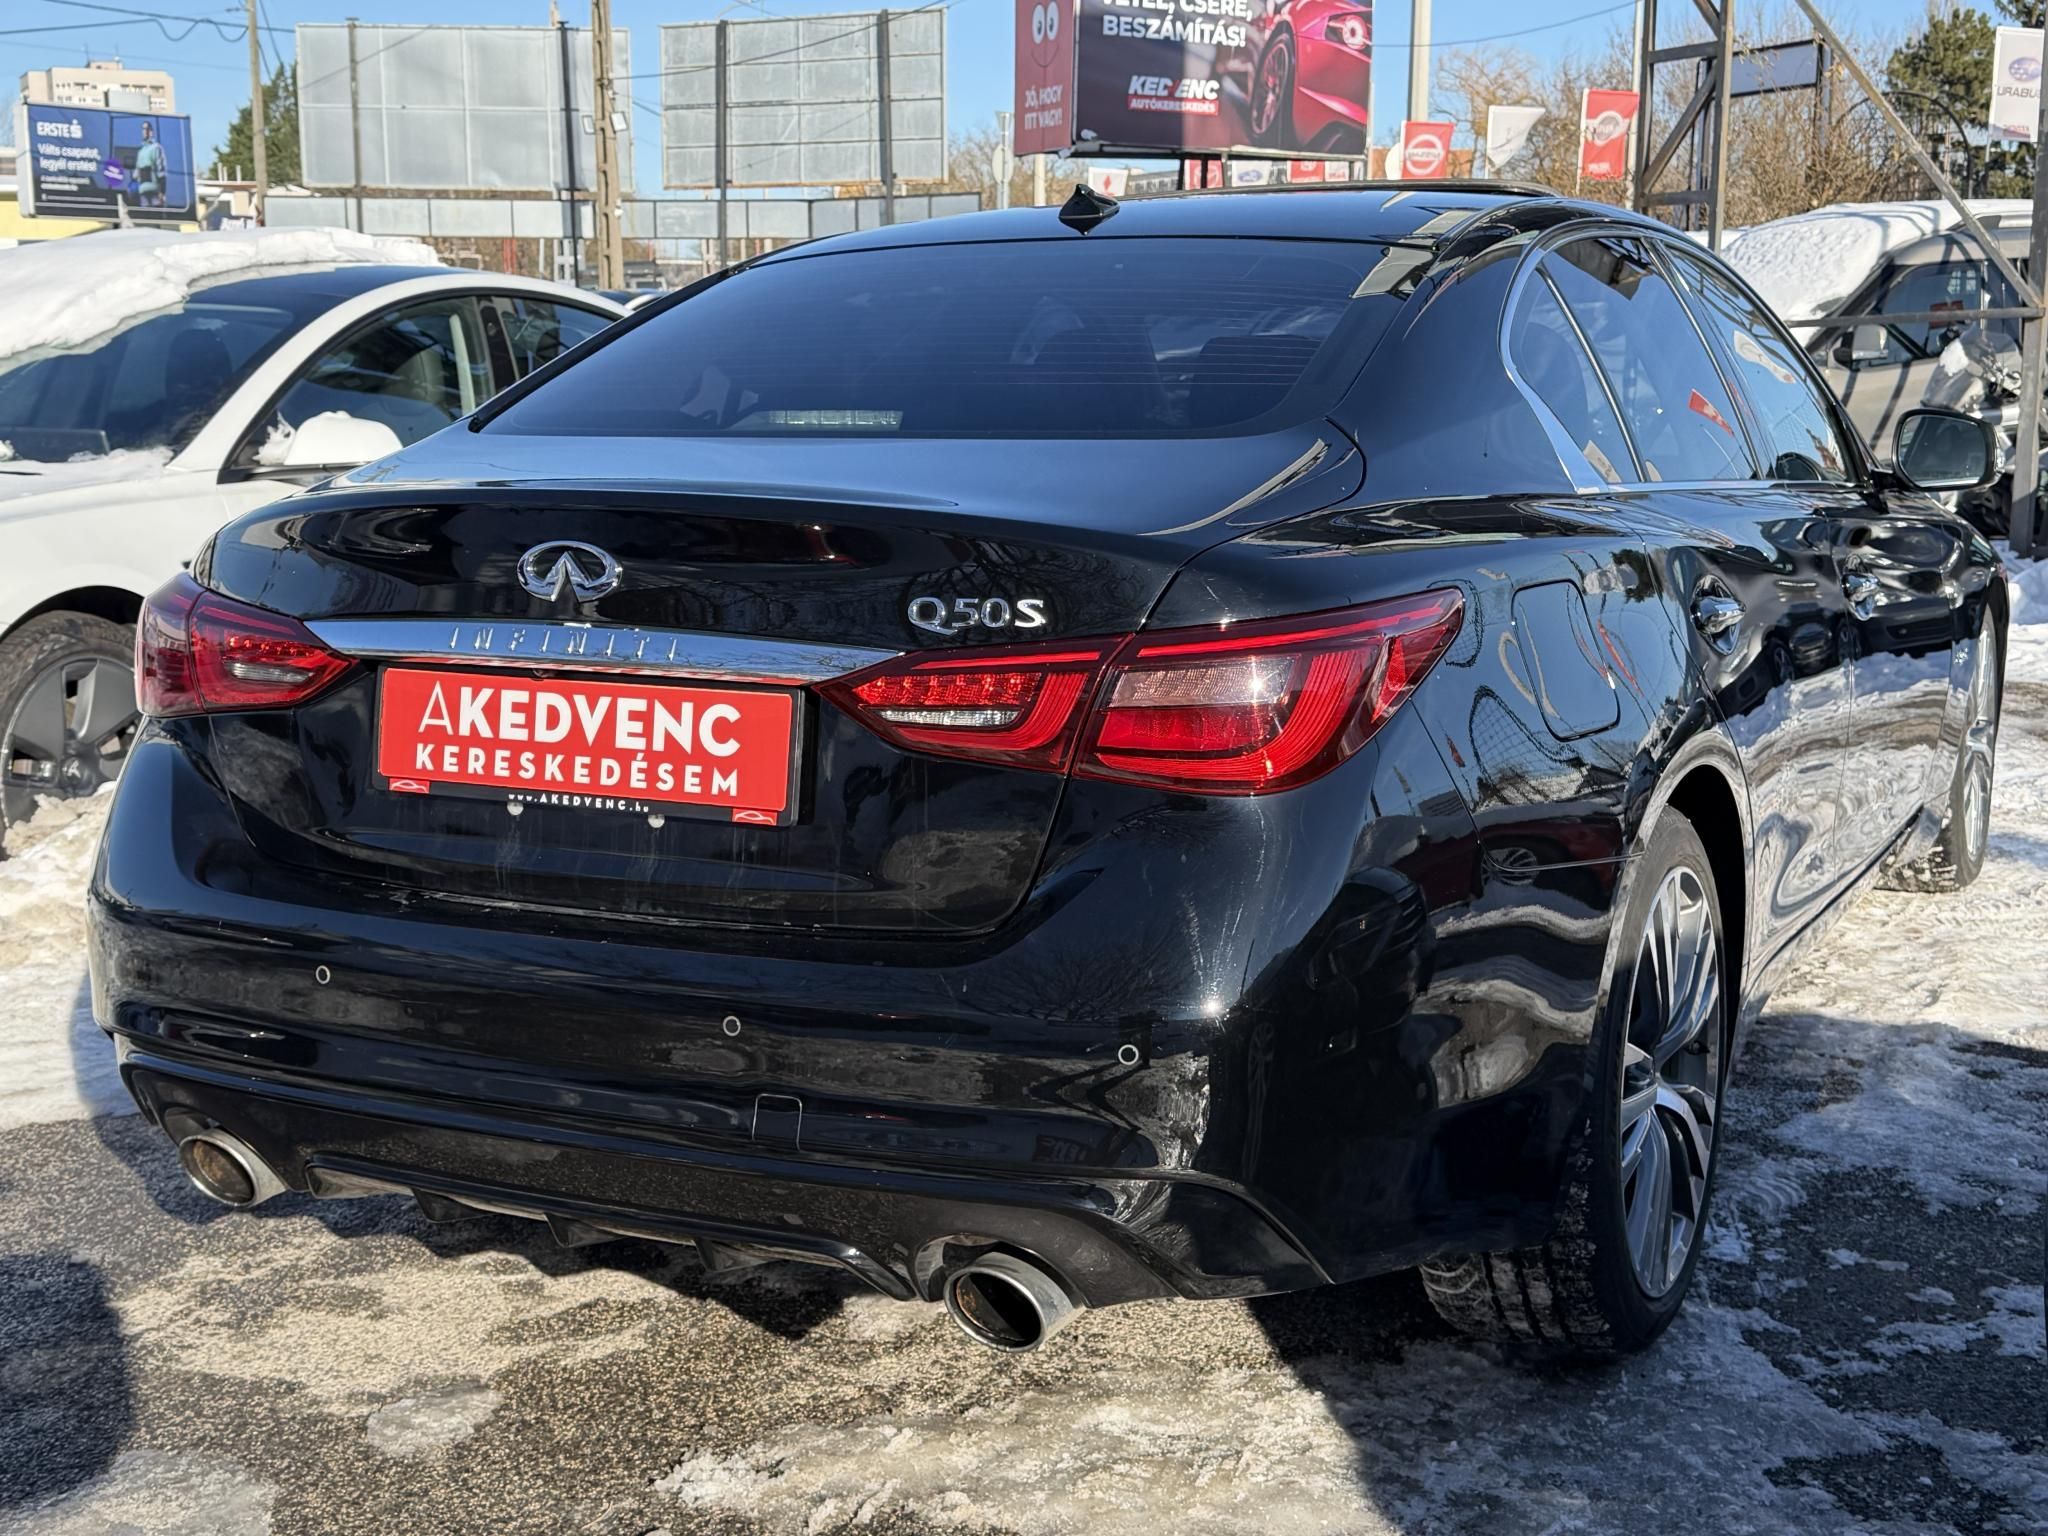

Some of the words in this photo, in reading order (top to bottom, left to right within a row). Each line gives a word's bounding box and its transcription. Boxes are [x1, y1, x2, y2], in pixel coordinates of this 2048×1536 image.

[1102, 15, 1247, 47] BESZÁMÍTÁS!
[36, 121, 70, 138] ERSTE
[450, 626, 678, 662] INFINITI
[415, 742, 738, 797] KERESKEDÉSEM
